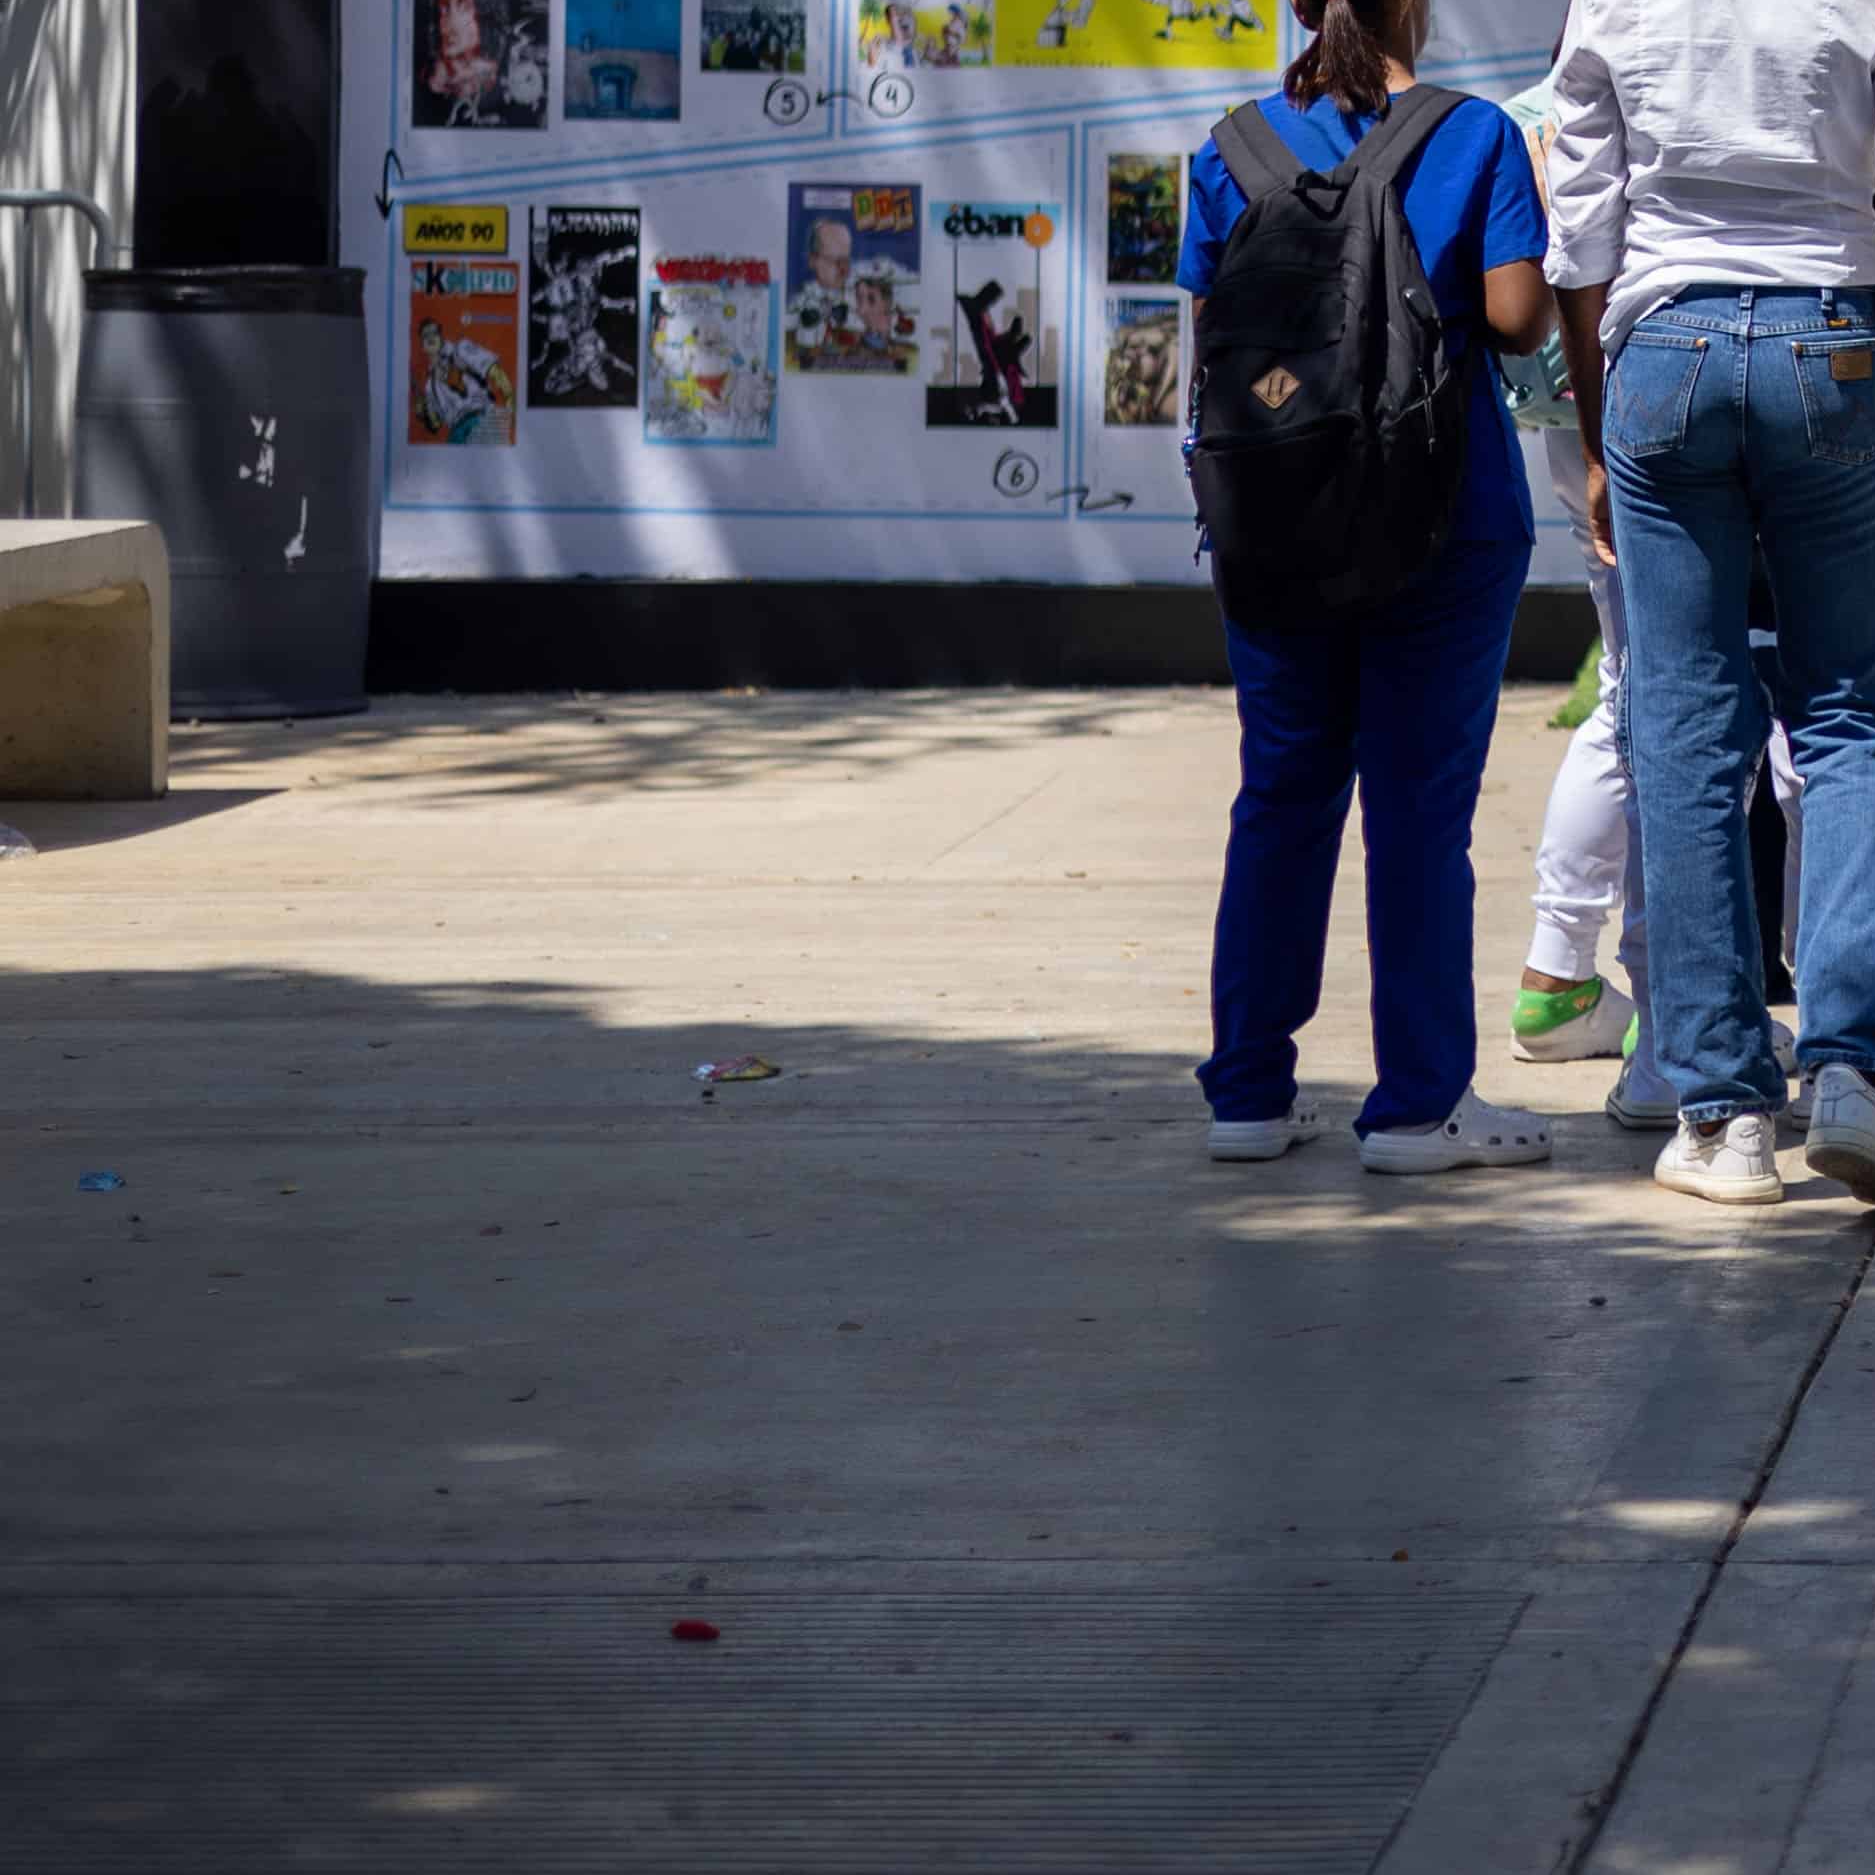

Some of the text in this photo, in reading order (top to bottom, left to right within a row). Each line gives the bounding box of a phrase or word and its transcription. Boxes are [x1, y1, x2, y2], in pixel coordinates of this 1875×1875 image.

[780, 91, 796, 116] 5
[884, 85, 899, 107] 4
[415, 216, 496, 242] AÑOS 90
[1009, 462, 1026, 487] 6
